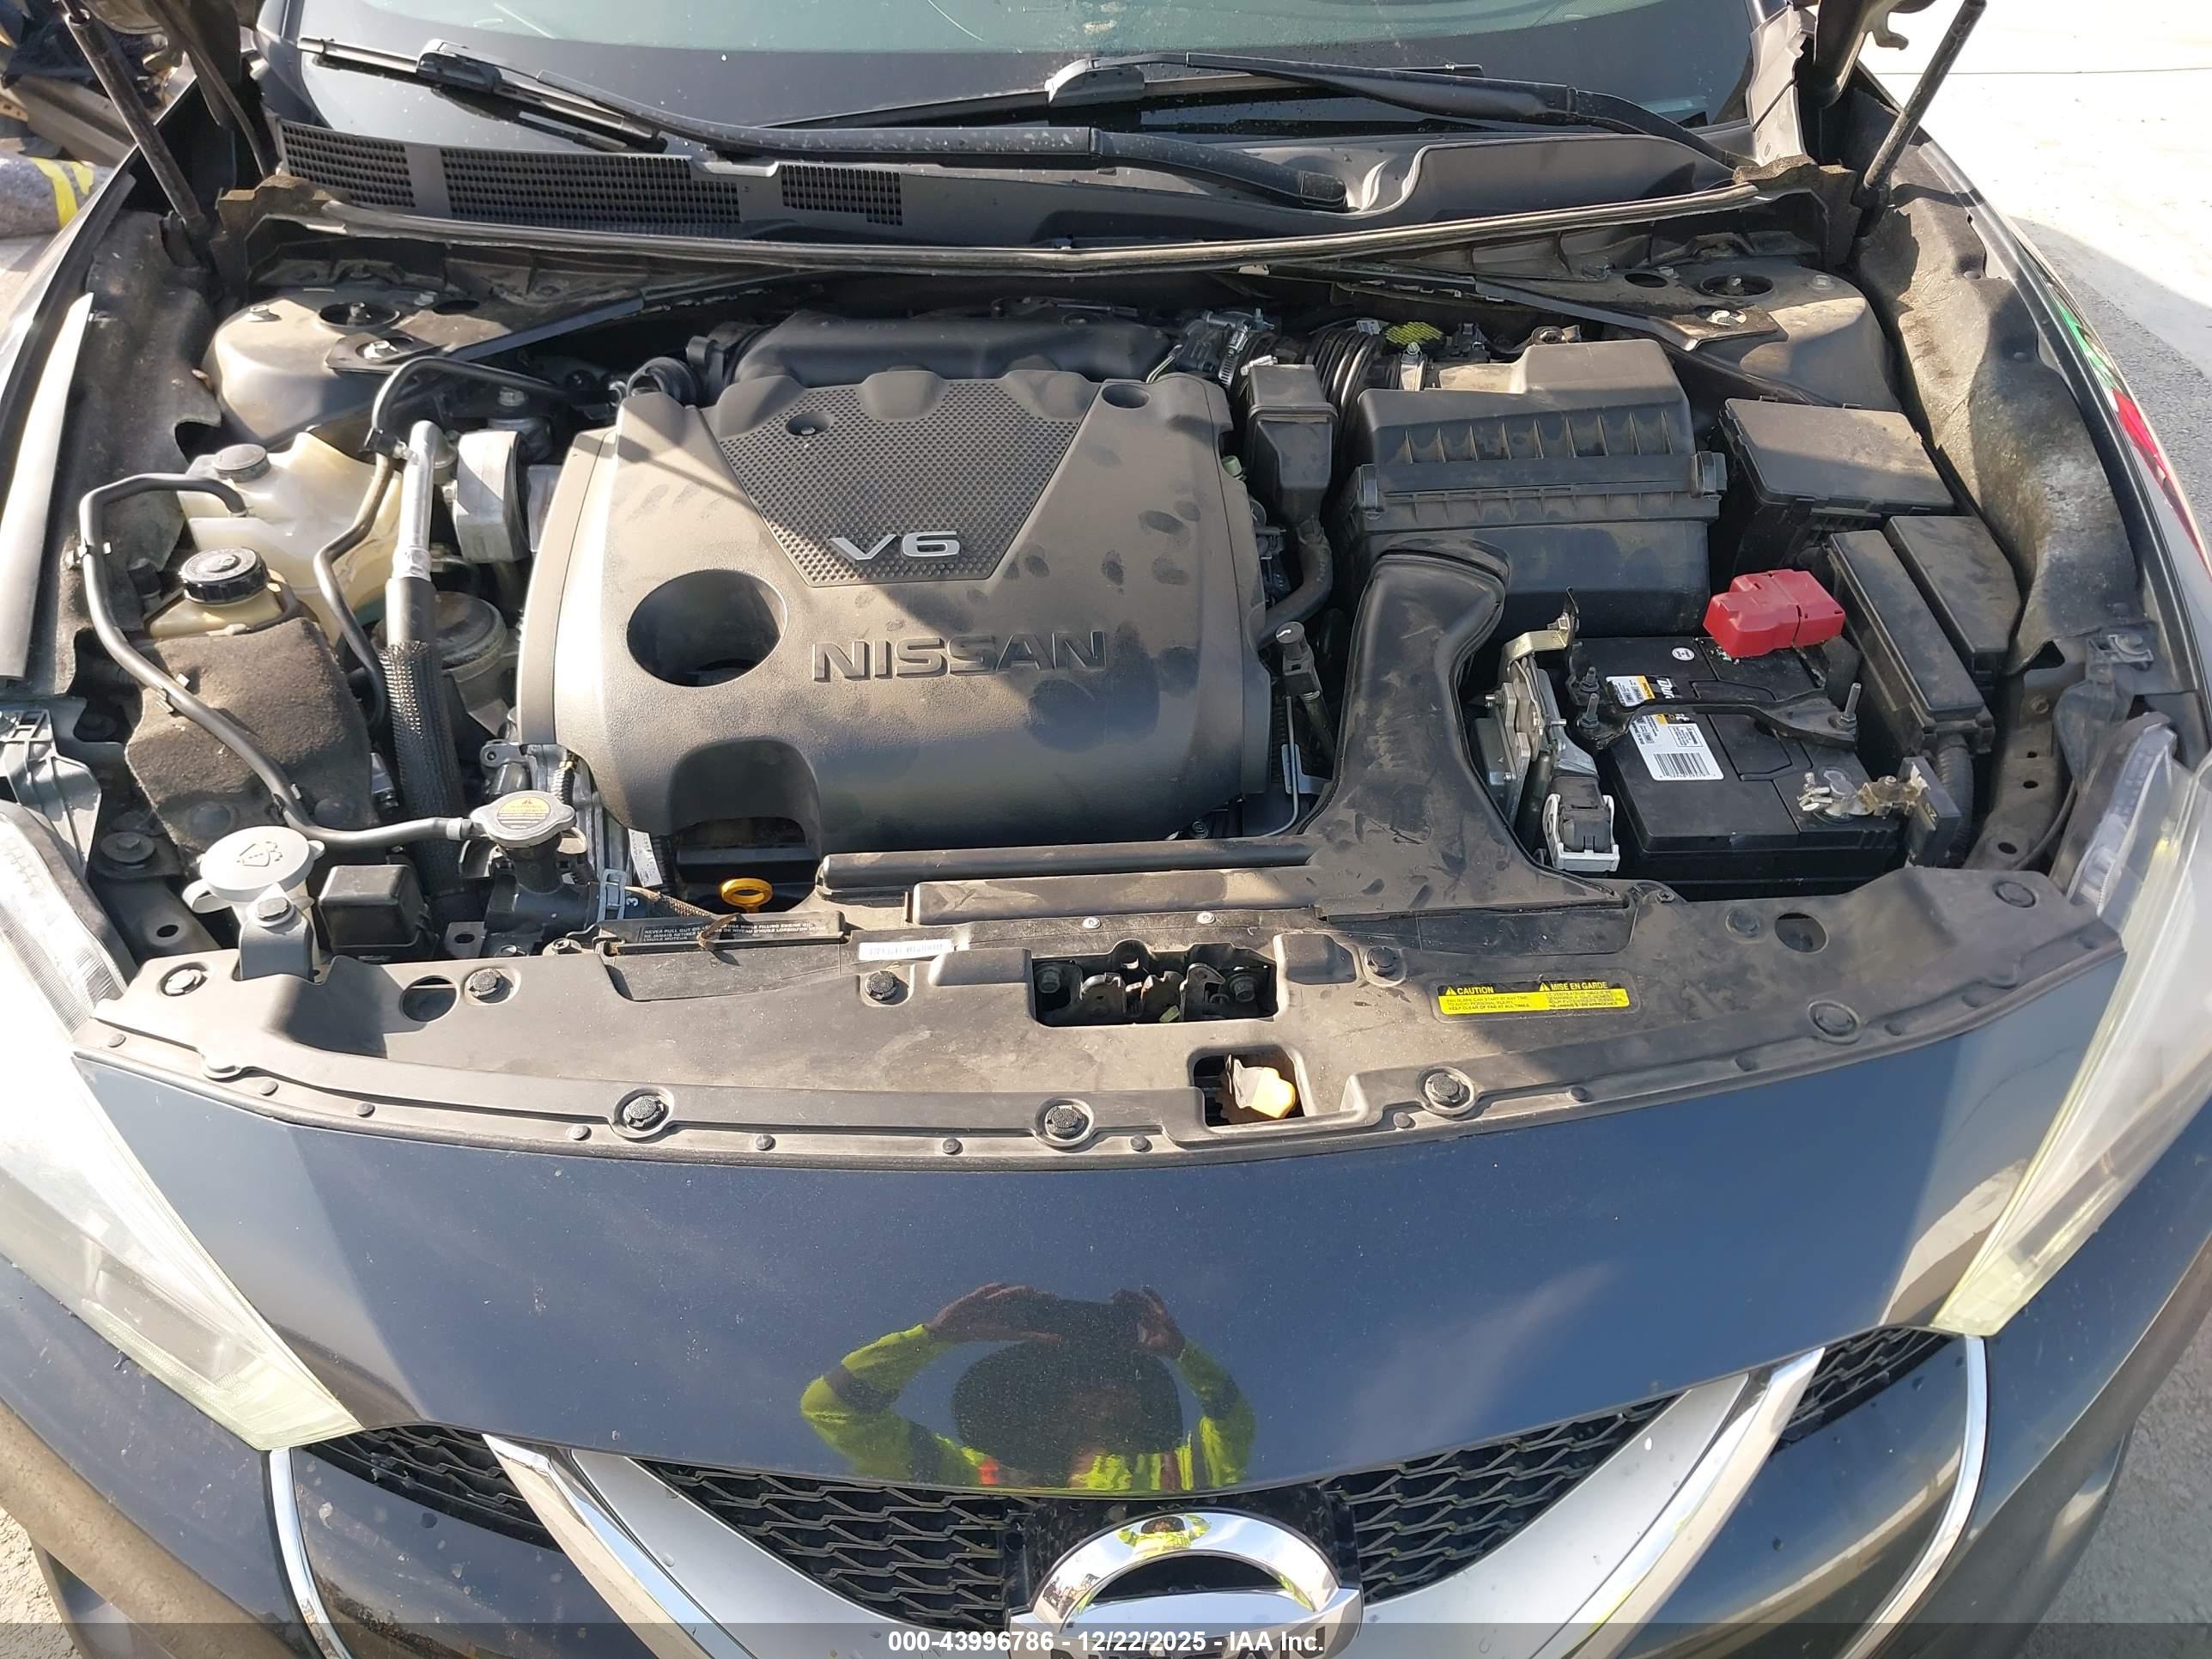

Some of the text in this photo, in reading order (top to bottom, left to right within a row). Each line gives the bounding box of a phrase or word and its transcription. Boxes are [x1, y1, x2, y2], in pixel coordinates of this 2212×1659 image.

[830, 531, 960, 561] V6
[812, 630, 1107, 683] NISSAN
[1550, 982, 1570, 991] MISE
[1581, 981, 1608, 990] GARDE
